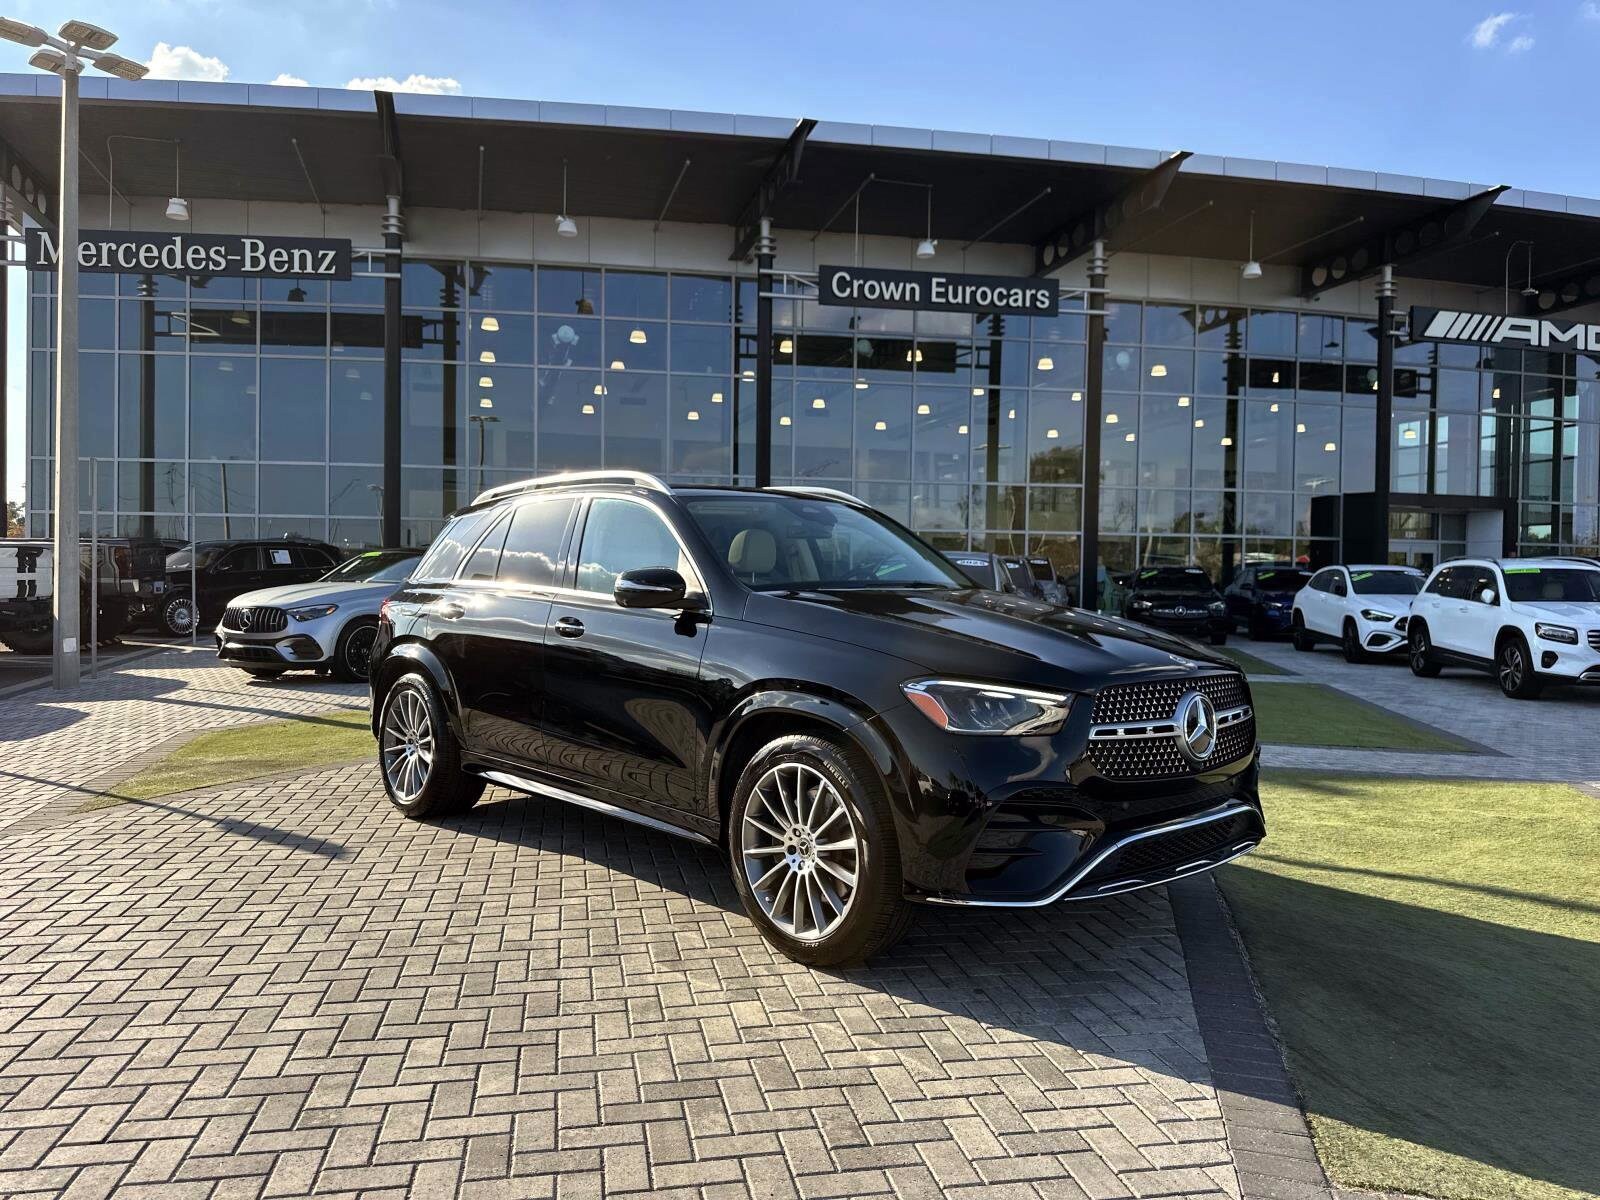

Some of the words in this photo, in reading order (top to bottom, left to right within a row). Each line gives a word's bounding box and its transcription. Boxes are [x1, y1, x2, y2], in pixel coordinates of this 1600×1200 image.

[36, 231, 337, 275] Mercedes-Benz
[831, 271, 921, 302] Crown
[930, 277, 1051, 309] Eurocars
